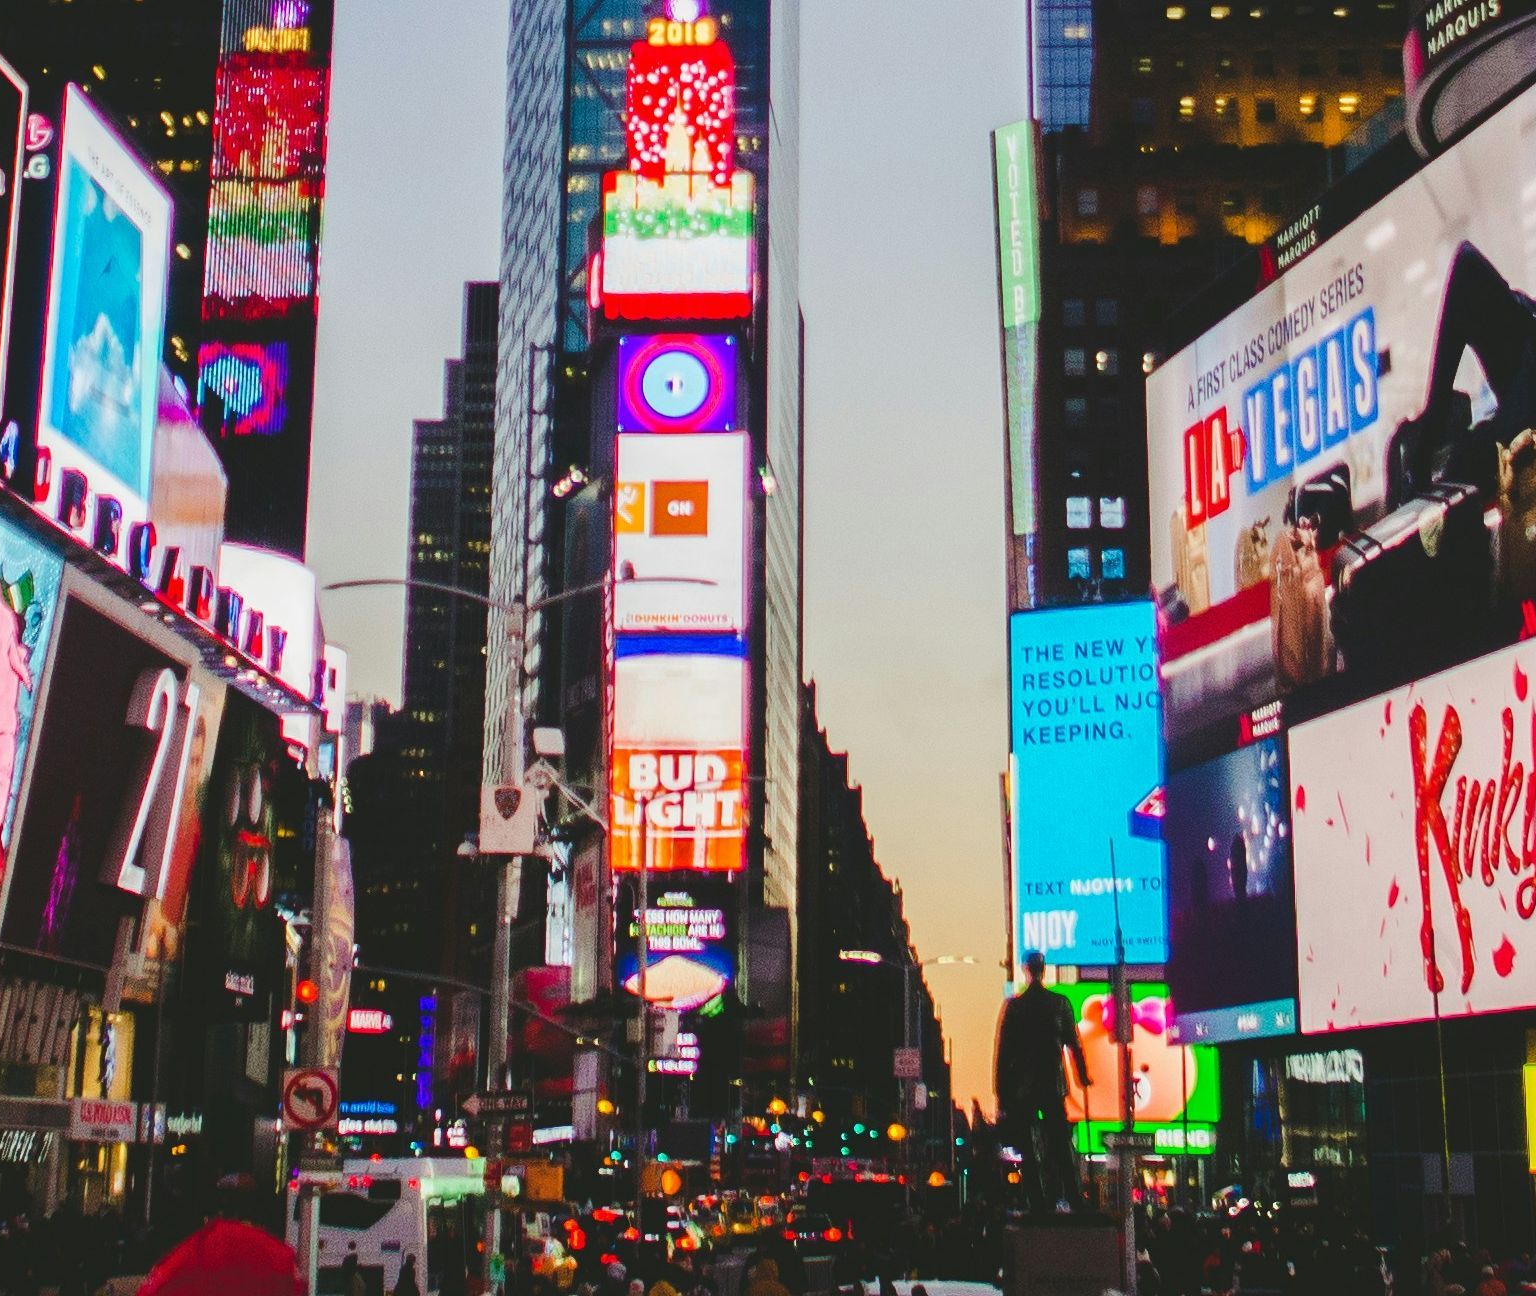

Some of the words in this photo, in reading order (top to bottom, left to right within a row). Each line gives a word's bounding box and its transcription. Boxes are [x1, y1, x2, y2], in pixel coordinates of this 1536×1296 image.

[648, 18, 718, 46] 2018
[1276, 204, 1321, 250] MARRIOTT
[1277, 230, 1318, 270] MARQUIS
[1187, 383, 1196, 411] A
[1197, 360, 1227, 403] FIRST
[1228, 338, 1266, 388] CLASS
[1267, 305, 1319, 354] COMEDY
[1318, 262, 1366, 316] SERIES
[1188, 418, 1230, 520] LA
[1246, 315, 1375, 484] VEGAS
[666, 499, 694, 518] ON
[1022, 645, 1066, 664] THE
[1074, 639, 1127, 661] NEW
[1021, 664, 1156, 692] RESOLUTIO
[1021, 692, 1106, 717] YOU'LL
[1113, 689, 1163, 713] NJO
[1021, 721, 1134, 745] KEEPING.
[629, 754, 727, 792] BUD
[613, 789, 740, 828] LIGHT
[1025, 880, 1064, 896] TEXT
